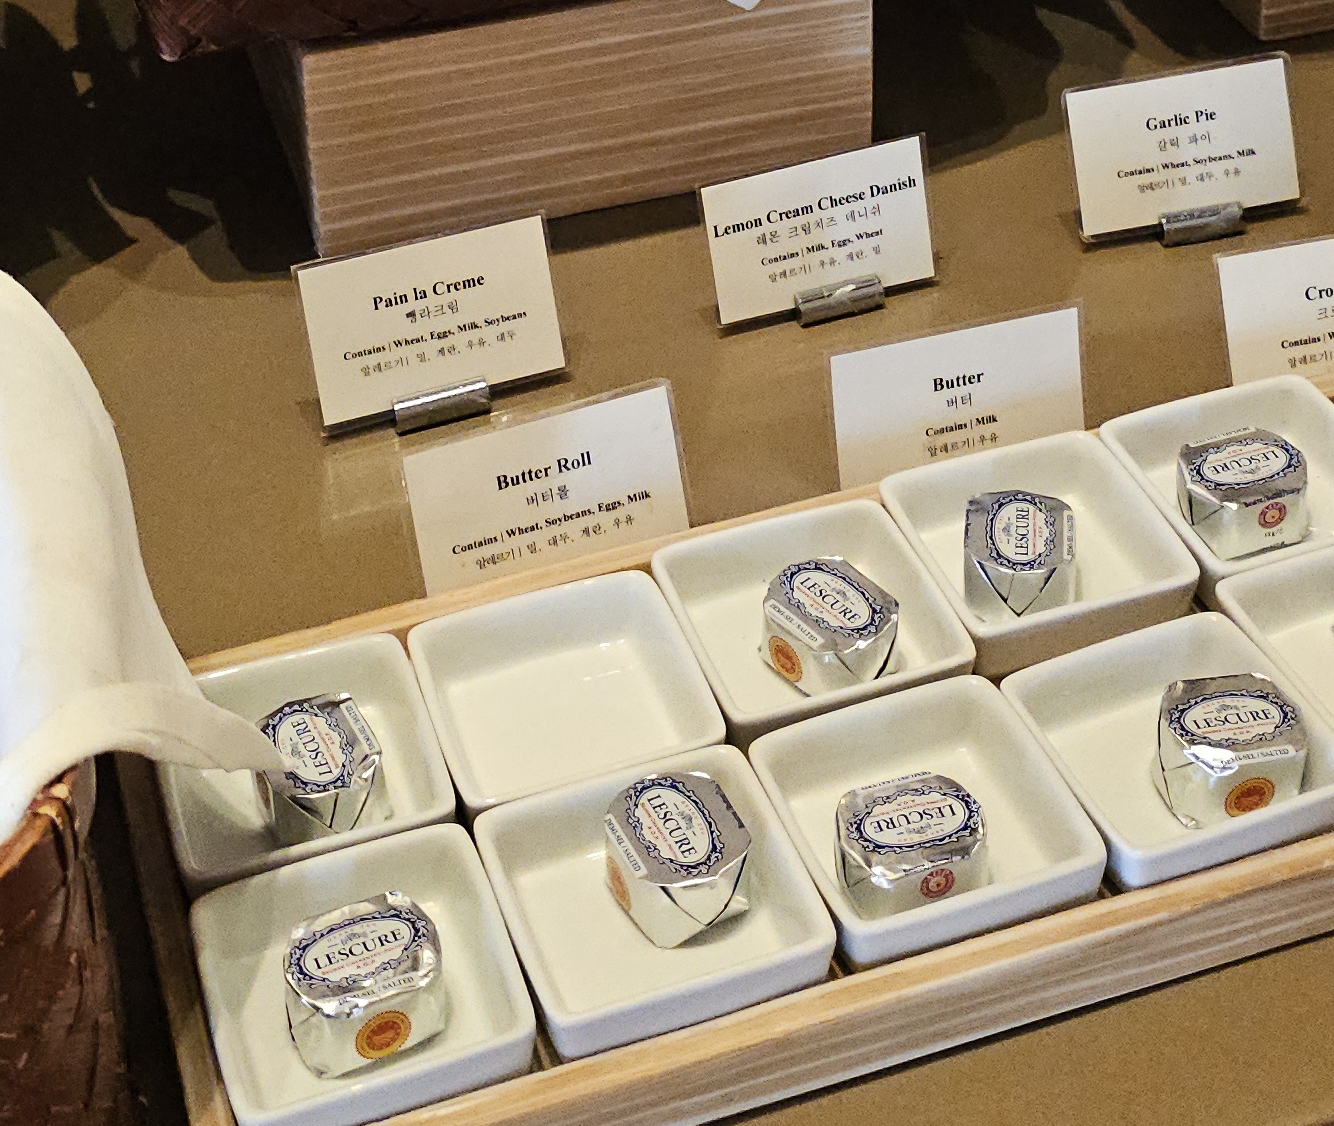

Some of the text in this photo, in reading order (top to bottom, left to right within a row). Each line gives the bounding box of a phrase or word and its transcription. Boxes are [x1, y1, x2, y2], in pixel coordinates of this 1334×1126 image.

[1146, 108, 1217, 131] Garlic Pie
[1188, 130, 1211, 146] 파이
[1117, 166, 1155, 178] Contains
[1193, 154, 1235, 166] Soybeans,
[713, 175, 917, 238] Lemon Cream Cheese Danish
[756, 230, 780, 246] 레몬
[788, 217, 838, 239] 크림치즈
[761, 251, 800, 266] Contains
[855, 228, 883, 240] Wheat
[372, 275, 485, 311] Pain la Creme
[343, 344, 386, 360] Contains
[393, 335, 427, 348] Wheat,
[457, 321, 482, 333] Milk,
[484, 311, 527, 327] Soybeans
[1281, 335, 1322, 349] Contains
[933, 372, 984, 392] Butter
[946, 392, 972, 409] 버터
[925, 422, 968, 437] Contains
[975, 414, 998, 426] Milk
[496, 451, 592, 491] Butter Roll
[1207, 450, 1280, 476] LESCURE
[452, 535, 498, 555] Contains
[505, 522, 543, 538] Wheat,
[544, 508, 595, 527] Soybeans,
[597, 499, 625, 513] Eggs,
[627, 490, 652, 505] Milk
[1015, 506, 1030, 557] LESCURE
[799, 576, 862, 624] LESCURE
[1192, 708, 1275, 730] LESCURE
[291, 717, 334, 777] LESCURE
[646, 794, 699, 859] LESCURE
[870, 803, 957, 834] LESCURE
[313, 928, 405, 970] LESCURE
